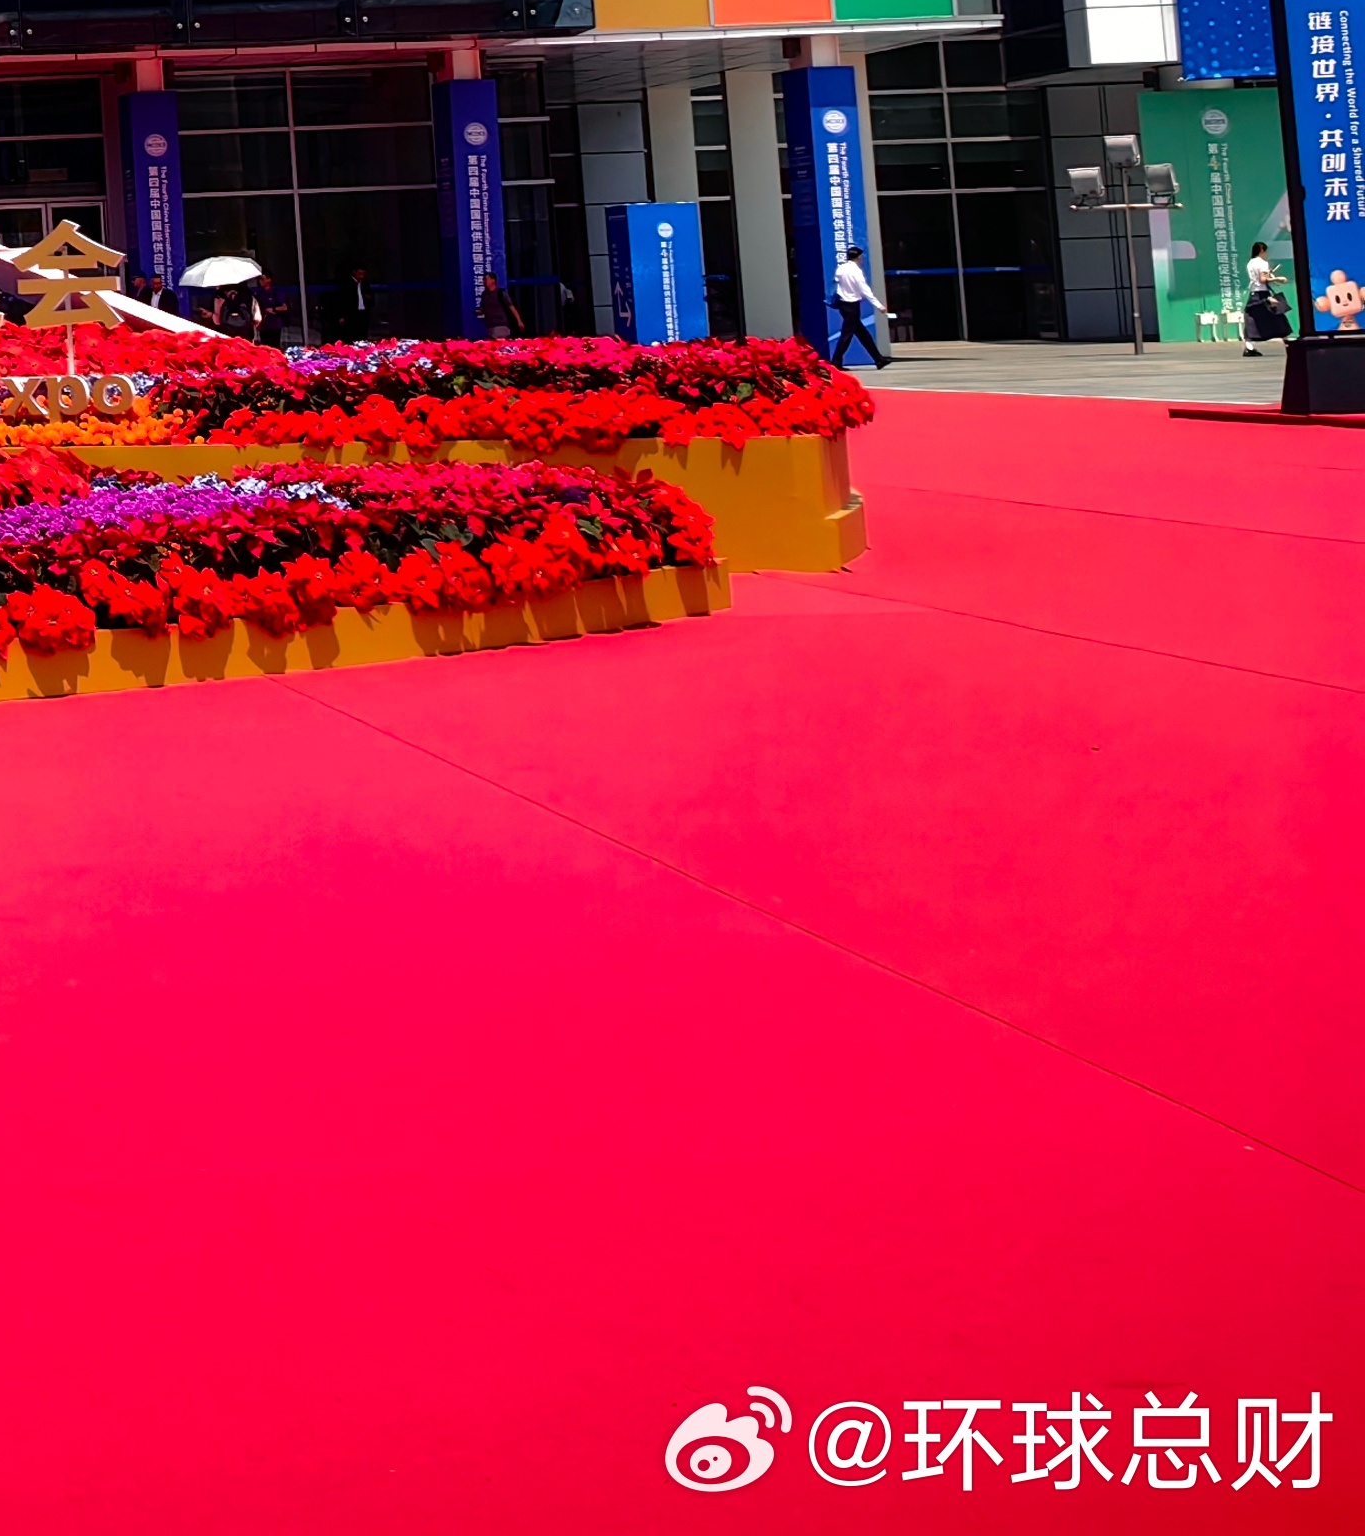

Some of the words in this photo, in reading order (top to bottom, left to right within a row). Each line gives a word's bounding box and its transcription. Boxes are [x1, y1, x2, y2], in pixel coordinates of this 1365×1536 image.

[1339, 9, 1352, 66] Connecting
[1344, 66, 1356, 85] the
[1347, 86, 1359, 119] World
[1349, 119, 1359, 133] for
[1352, 147, 1365, 182] Shared
